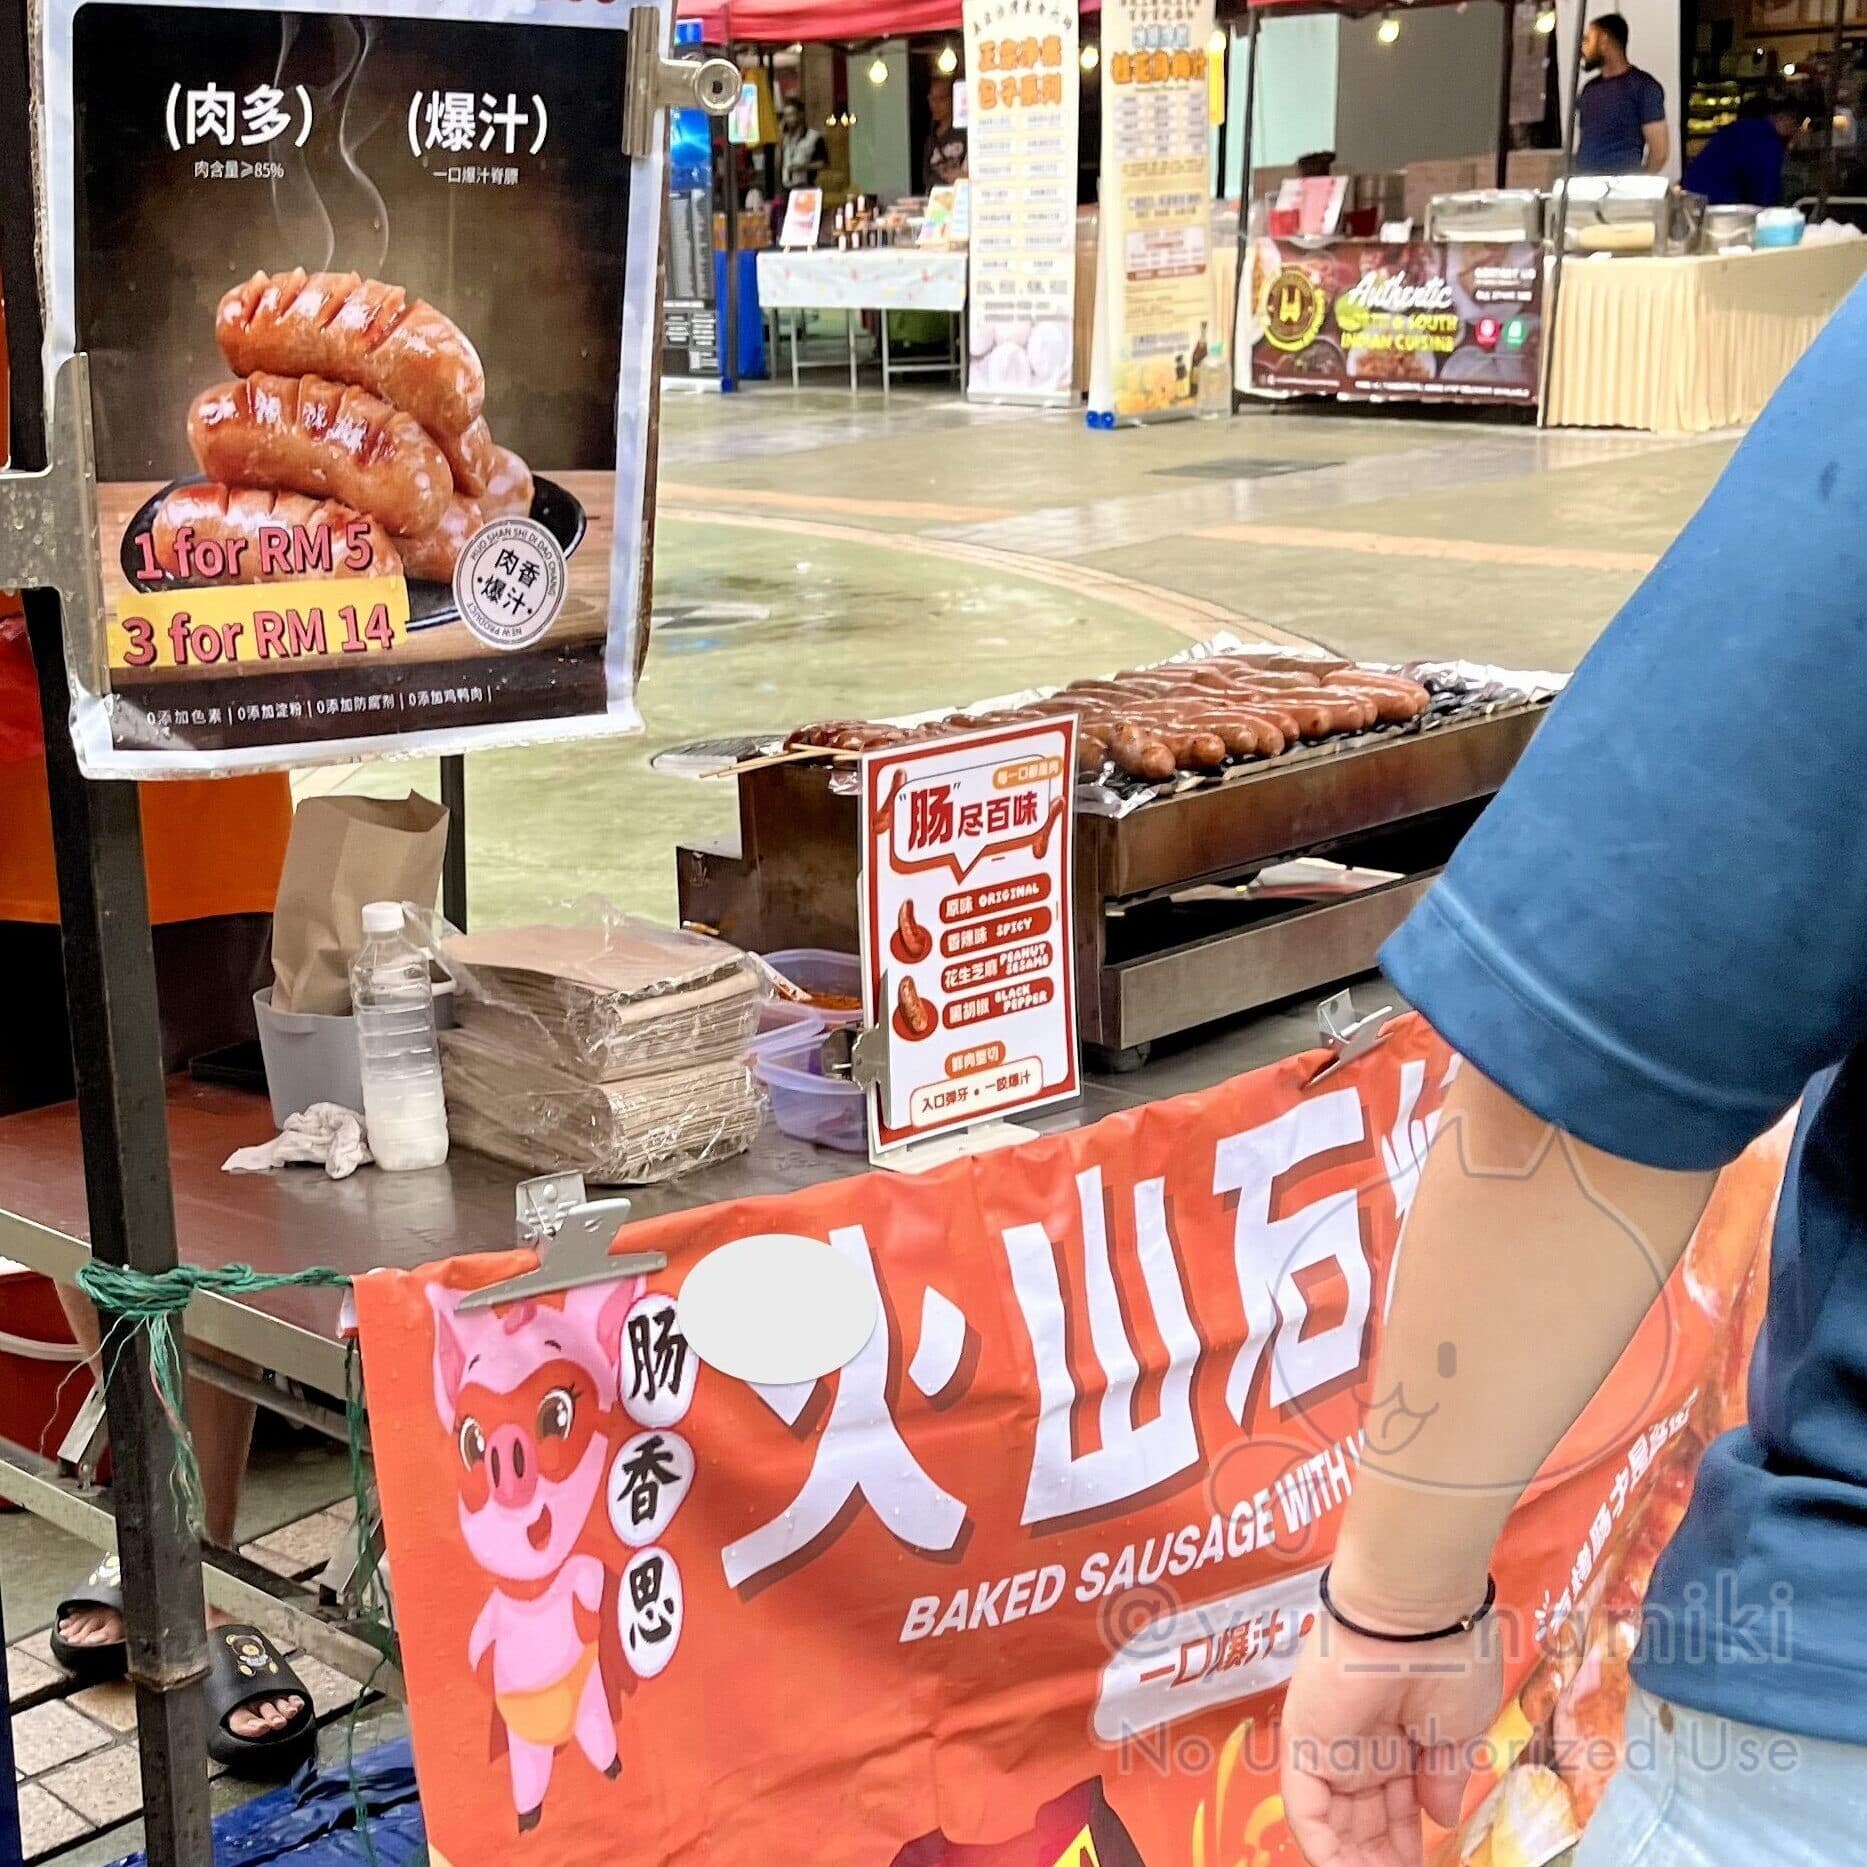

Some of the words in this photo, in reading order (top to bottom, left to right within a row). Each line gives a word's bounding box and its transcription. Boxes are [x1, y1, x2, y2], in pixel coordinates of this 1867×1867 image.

[1348, 270, 1454, 312] Authentic
[134, 535, 163, 580] 1
[174, 527, 244, 578] for
[259, 526, 333, 575] RM
[346, 523, 373, 570] 5
[121, 616, 156, 665] 3
[170, 609, 243, 664] for
[255, 607, 329, 658] RM
[340, 604, 395, 652] 14
[978, 881, 1040, 906] ORIGINAL
[995, 916, 1033, 939] SPICY
[999, 942, 1048, 967] PEANUT
[1005, 953, 1050, 976] SESAME
[994, 984, 1031, 1004] BLACK
[1003, 990, 1049, 1013] PEPPER
[900, 1565, 1067, 1643] BAKED
[1076, 1487, 1276, 1603] SAUSAGE
[1273, 1443, 1354, 1535] WITH
